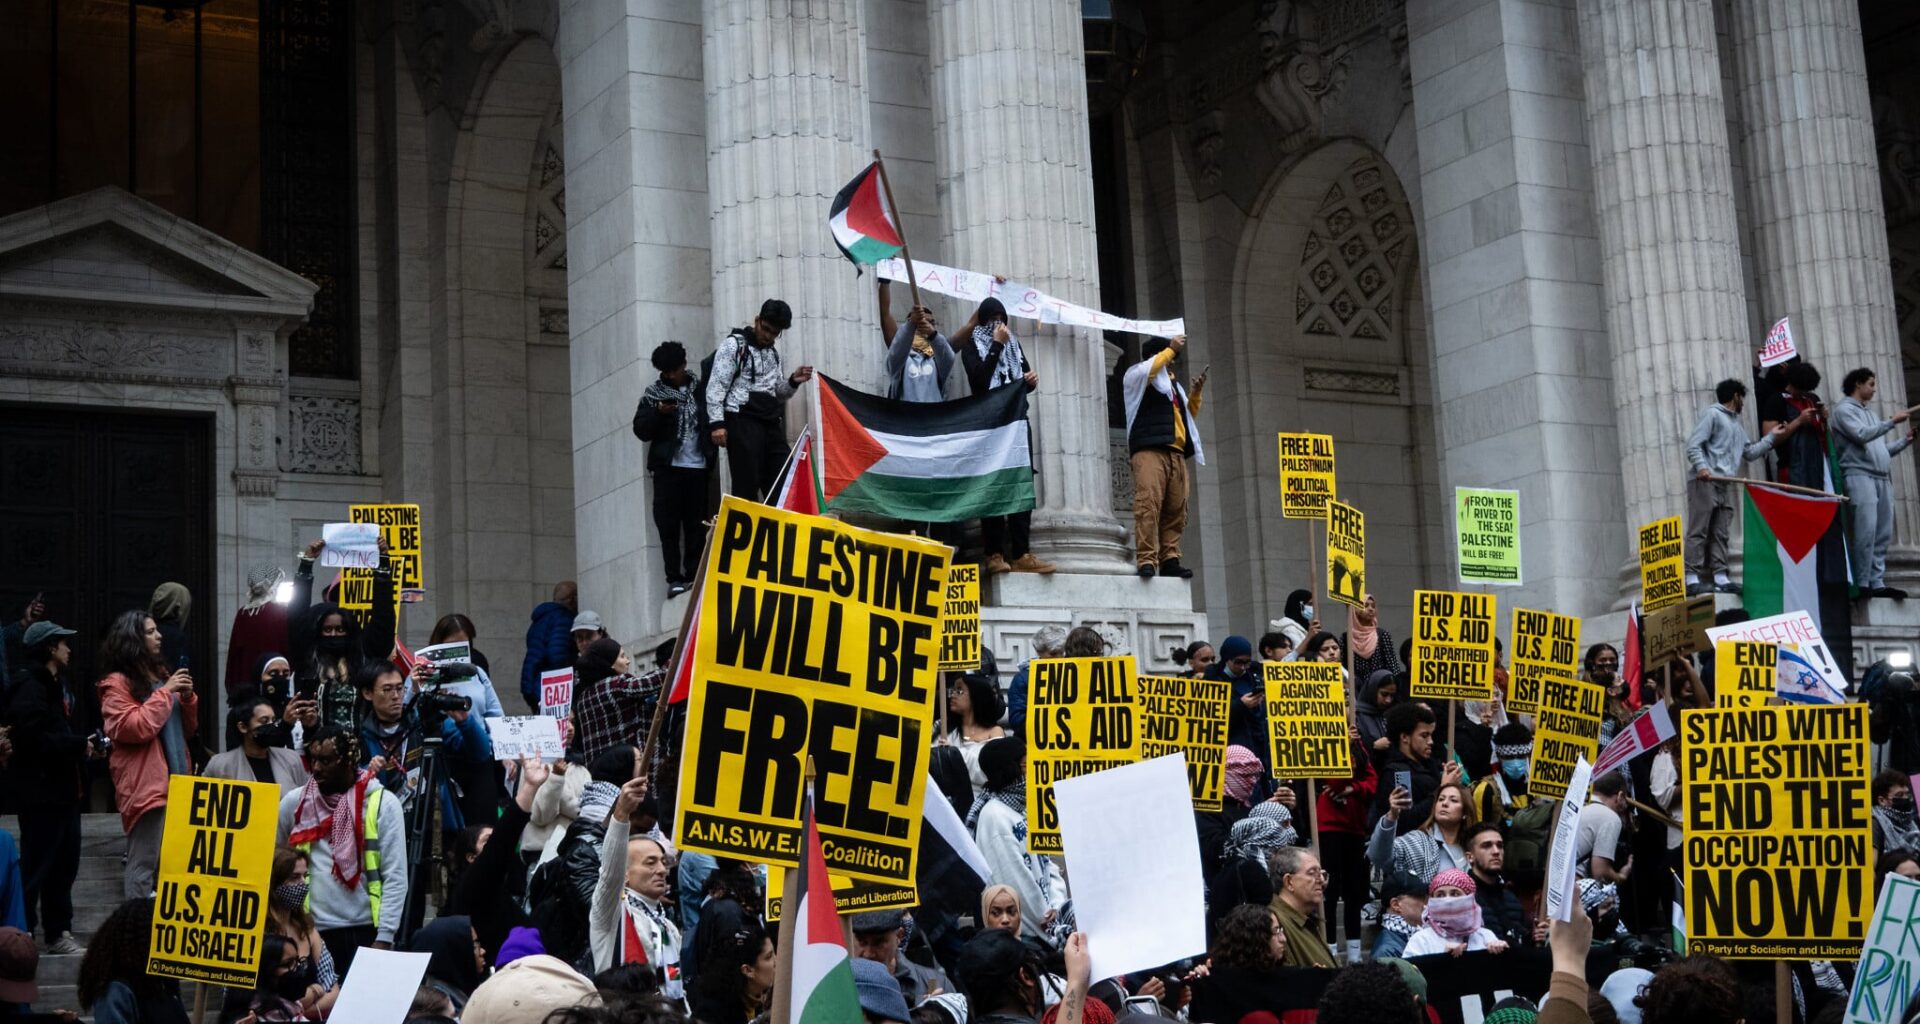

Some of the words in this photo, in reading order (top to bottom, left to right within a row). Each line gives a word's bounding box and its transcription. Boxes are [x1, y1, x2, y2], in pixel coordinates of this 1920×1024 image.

[1281, 437, 1309, 455] FREE
[1313, 438, 1332, 457] ALL
[1281, 458, 1333, 473] PALESTINIAN
[1287, 477, 1330, 492] POLITICAL
[1470, 496, 1494, 507] FROM
[1495, 497, 1512, 508] THE
[1474, 508, 1498, 519] RIVER
[1500, 510, 1512, 520] TO
[352, 507, 418, 526] PALESTINE
[1330, 502, 1362, 542] FREE
[1477, 521, 1493, 531] THE
[1495, 522, 1513, 533] SEA!
[400, 527, 418, 550] BE
[1328, 531, 1364, 559] PALESTINE
[1461, 533, 1513, 548] PALESTINE
[1640, 525, 1659, 550] FREE
[1662, 520, 1680, 542] ALL
[327, 549, 377, 567] DYING
[718, 510, 945, 618] PALESTINE
[1462, 549, 1476, 558] WILL
[1478, 550, 1487, 559] BE
[1489, 551, 1504, 560] FREE!
[1641, 541, 1681, 567] PALESTINIAN
[1646, 563, 1678, 586] POLITICAL
[1644, 578, 1683, 603] PRISONERS!
[1419, 593, 1454, 617] END
[1459, 595, 1491, 619] ALL
[1419, 617, 1453, 642] U.S.
[1459, 619, 1489, 643] AID
[1517, 611, 1548, 637] END
[1552, 616, 1576, 642] ALL
[1661, 614, 1681, 631] Free
[716, 580, 851, 687] WILL
[866, 612, 932, 705] BE
[1418, 646, 1430, 659] TO
[1433, 647, 1489, 663] APARTHEID
[1516, 635, 1545, 661] U.S.
[1550, 640, 1573, 665] AID
[1735, 642, 1777, 667] END
[1266, 665, 1340, 681] RESISTANCE
[1419, 661, 1486, 687] ISRAEL!
[1515, 662, 1526, 676] TO
[1738, 668, 1776, 692] ALL
[545, 683, 570, 707] GAZA
[1034, 662, 1078, 705] END
[1088, 660, 1133, 704] ALL
[1137, 677, 1186, 697] STAND
[1190, 681, 1228, 700] WITH
[1280, 683, 1330, 699] AGAINST
[1415, 687, 1457, 696] A.N.S.W.E.R.
[1457, 688, 1489, 698] Coalition
[1139, 695, 1227, 720] PALESTINE!
[1269, 701, 1344, 717] OCCUPATION
[1543, 680, 1579, 712] FREE
[1579, 688, 1600, 717] ALL
[545, 706, 562, 720] WILL
[1539, 710, 1599, 739] PALESTINIAN
[1687, 710, 1777, 744] STAND
[1786, 707, 1863, 741] WITH
[1034, 706, 1080, 750] U.S.
[1089, 706, 1133, 750] AID
[1186, 718, 1226, 745] THE
[1274, 721, 1286, 737] IS
[1289, 721, 1298, 737] A
[1301, 721, 1346, 737] HUMAN
[694, 680, 921, 840] FREE!
[1275, 738, 1348, 767] RIGHT!
[1689, 743, 1864, 781] PALESTINE!
[1033, 760, 1049, 785] TO
[1533, 758, 1575, 785] PRISON
[189, 781, 252, 830] END
[1690, 782, 1772, 831] END
[1784, 780, 1867, 829] THE
[187, 829, 238, 878] ALL
[688, 820, 801, 854] A.N.S.W.E.
[822, 840, 904, 872] Coalition
[1689, 835, 1866, 867] OCCUPATION
[160, 881, 204, 924] U.S.
[209, 887, 260, 930] AID
[851, 895, 867, 906] and
[869, 890, 914, 903] Liberation
[1692, 867, 1863, 938] NOW!
[155, 923, 177, 954] TO
[180, 926, 256, 965] ISRAEL!
[1708, 945, 1732, 955] Party
[1734, 945, 1747, 954] for
[1750, 945, 1797, 955] Socialism
[1799, 945, 1817, 955] and
[161, 964, 176, 974] Party
[185, 968, 209, 978] Socialism
[224, 974, 255, 984] Liberation
